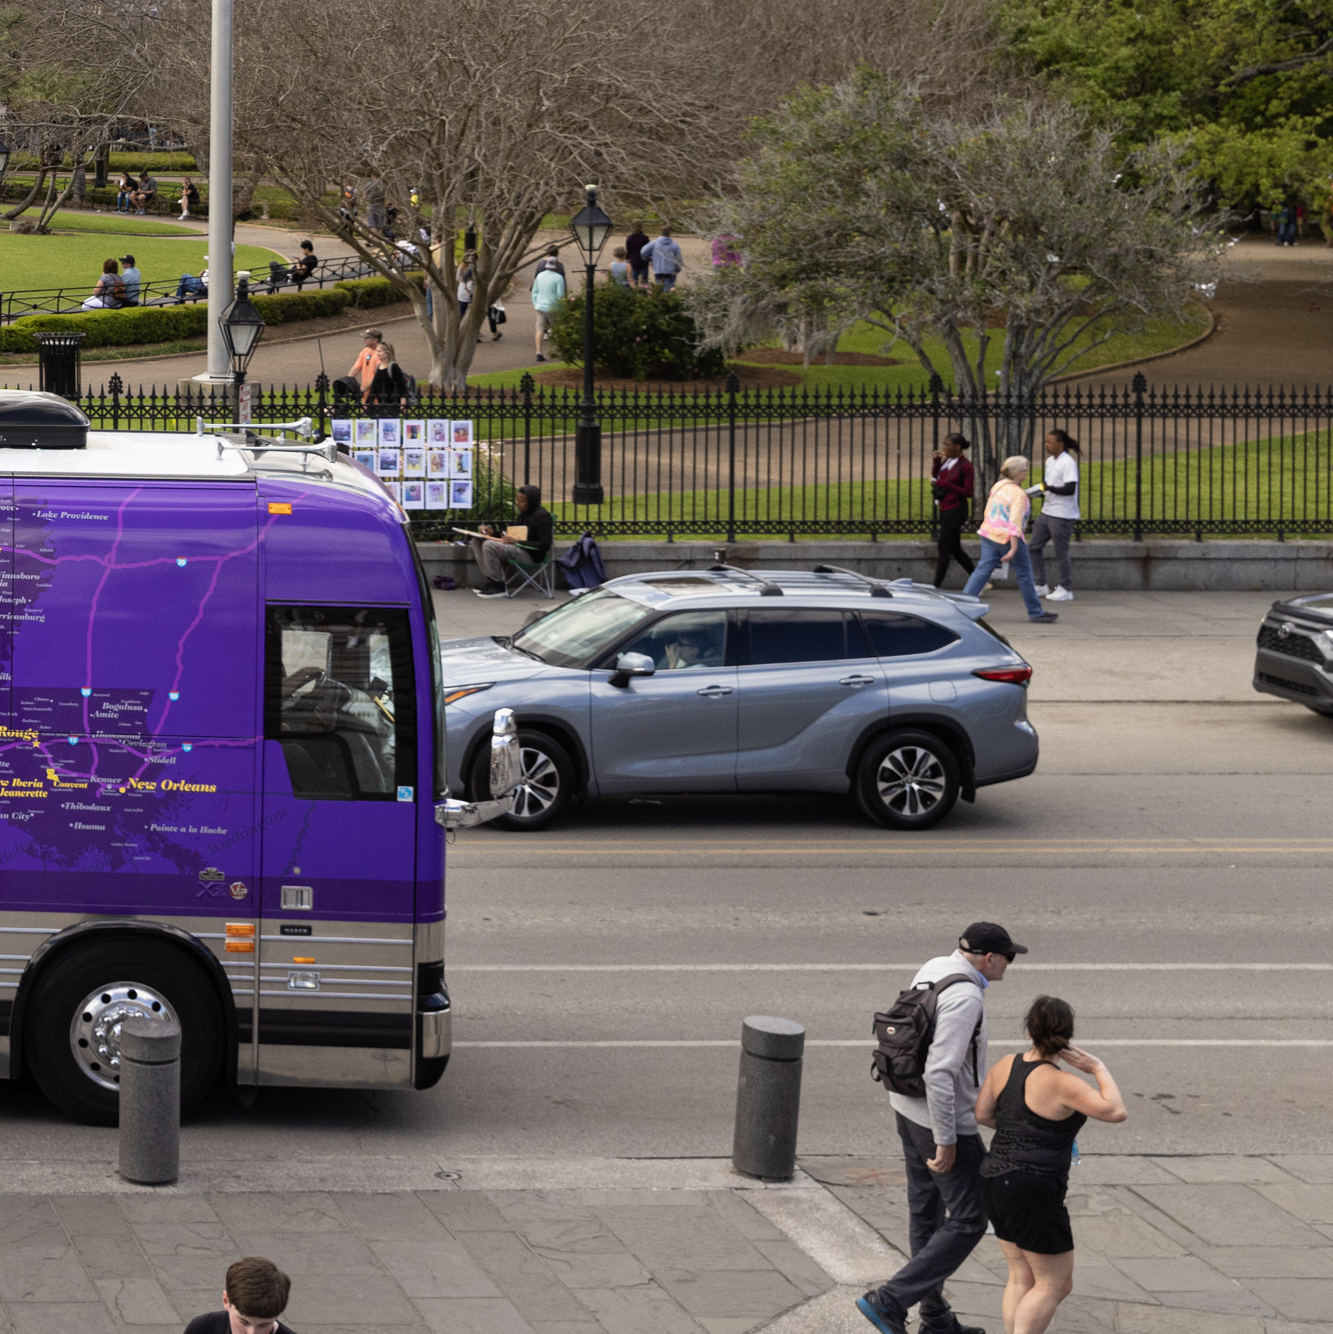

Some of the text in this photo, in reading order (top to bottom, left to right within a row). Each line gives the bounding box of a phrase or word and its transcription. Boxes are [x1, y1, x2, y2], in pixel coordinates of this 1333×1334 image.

[60, 512, 108, 520] Providence
[102, 702, 143, 713] Bogalusa
[92, 711, 119, 719] Amite
[148, 756, 177, 764] Slidell
[12, 778, 43, 788] Iberia
[90, 775, 122, 783] Kenner
[127, 778, 217, 792] New Orleans
[65, 802, 111, 811] Thibodaux
[12, 812, 30, 821] City
[74, 822, 106, 830] Houma
[150, 824, 227, 834] Pointe a la Hache
